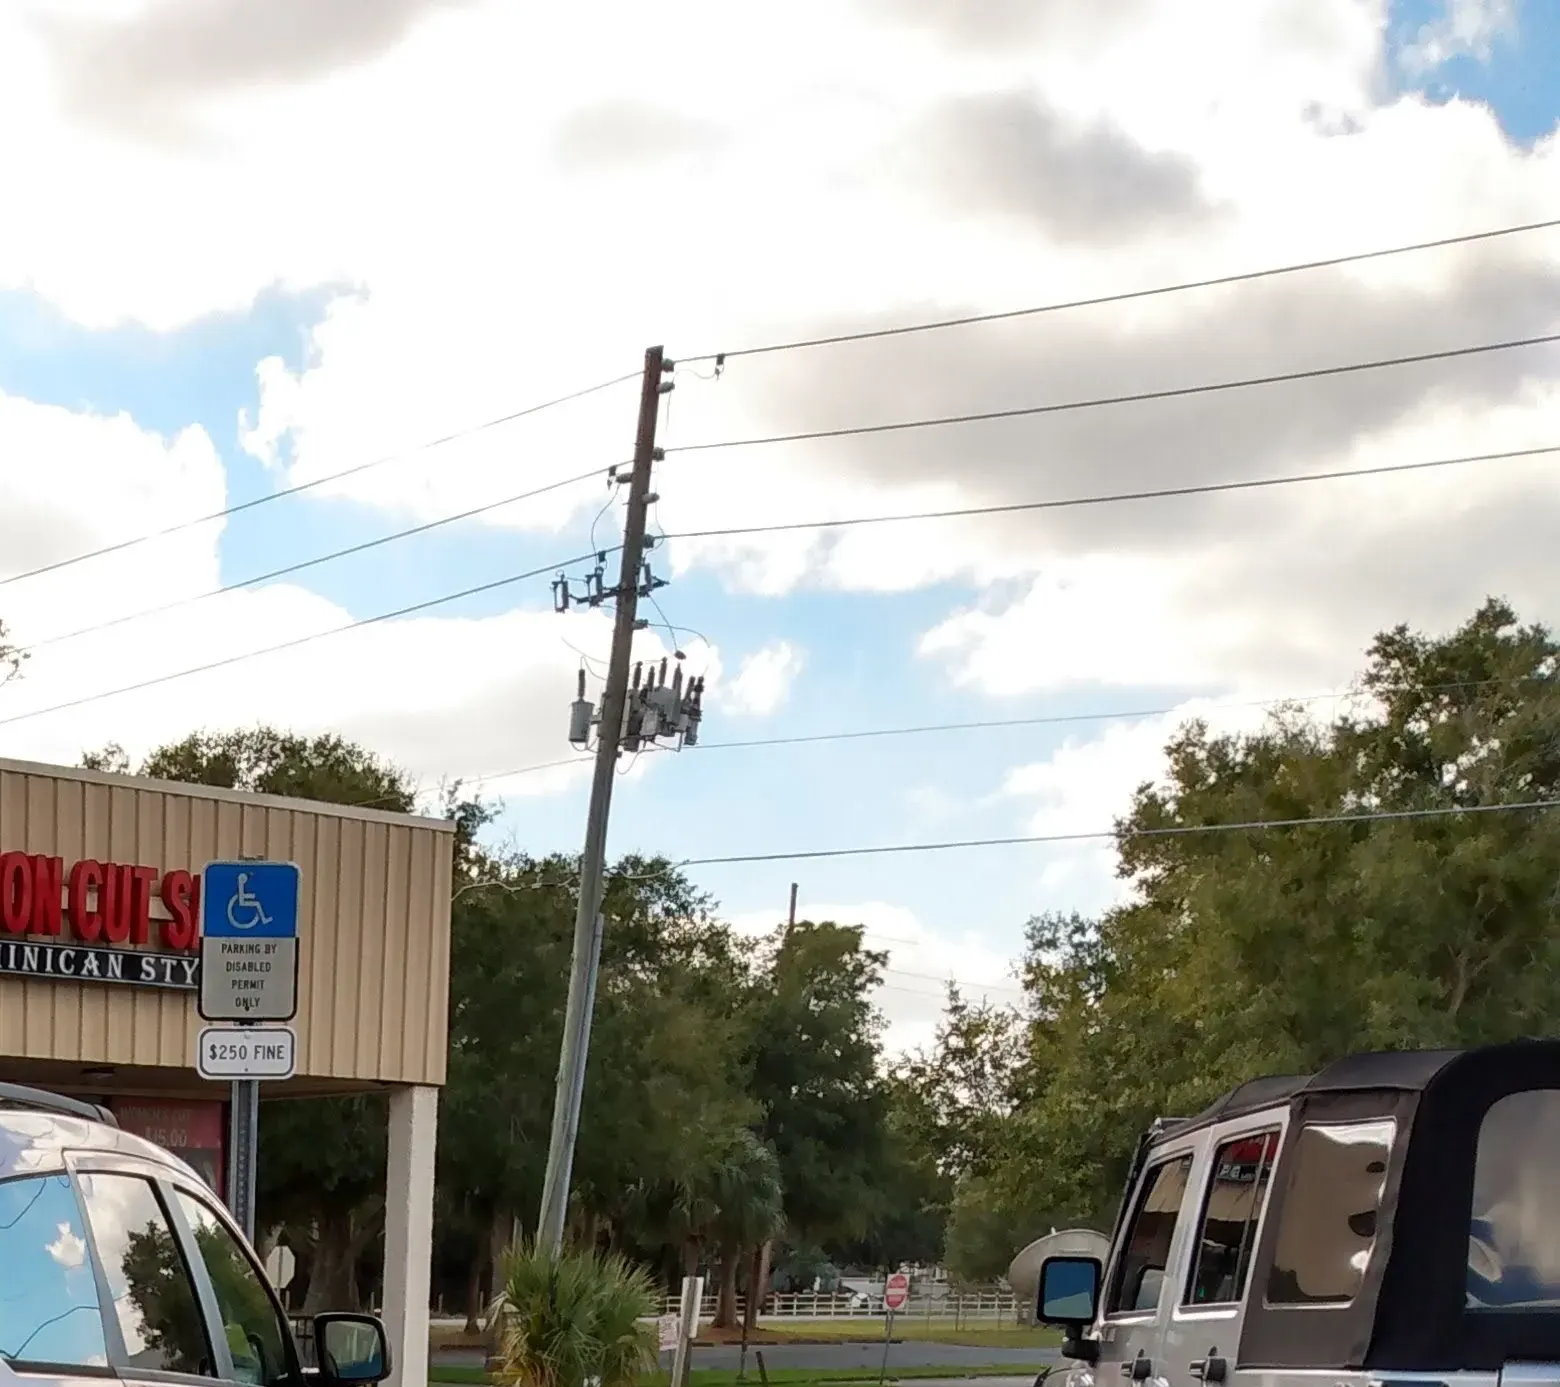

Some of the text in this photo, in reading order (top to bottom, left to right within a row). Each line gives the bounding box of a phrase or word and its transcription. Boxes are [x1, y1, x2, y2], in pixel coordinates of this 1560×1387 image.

[69, 859, 158, 945] CUT
[159, 869, 201, 950] S
[221, 943, 278, 954] PARKING BY
[226, 961, 271, 972] DISABLED
[231, 979, 265, 990] PERMIT
[235, 997, 260, 1008] ONLY
[209, 1044, 285, 1060] $250 FINE
